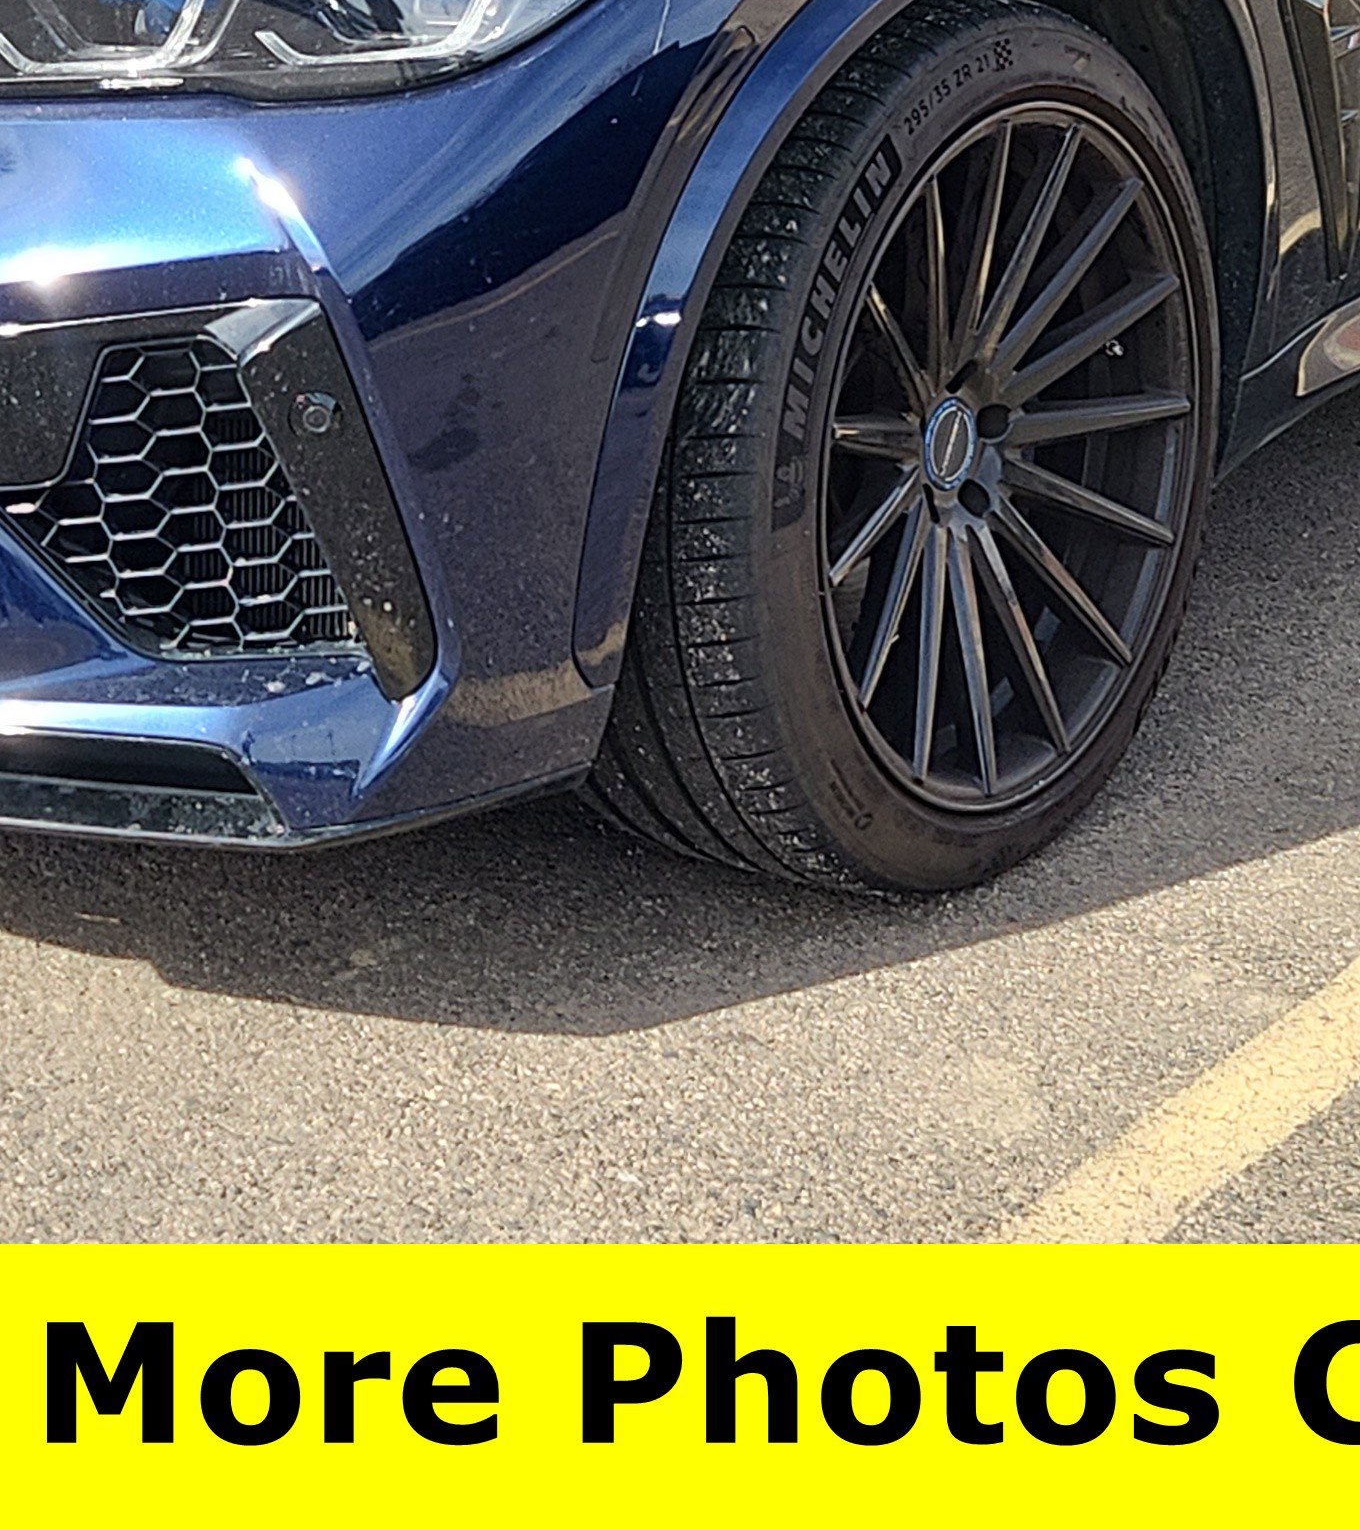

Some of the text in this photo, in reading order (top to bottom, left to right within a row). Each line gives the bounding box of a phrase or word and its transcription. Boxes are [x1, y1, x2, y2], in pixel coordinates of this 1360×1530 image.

[903, 53, 991, 136] 295/35 ZR 21
[782, 150, 894, 442] MICHELIN
